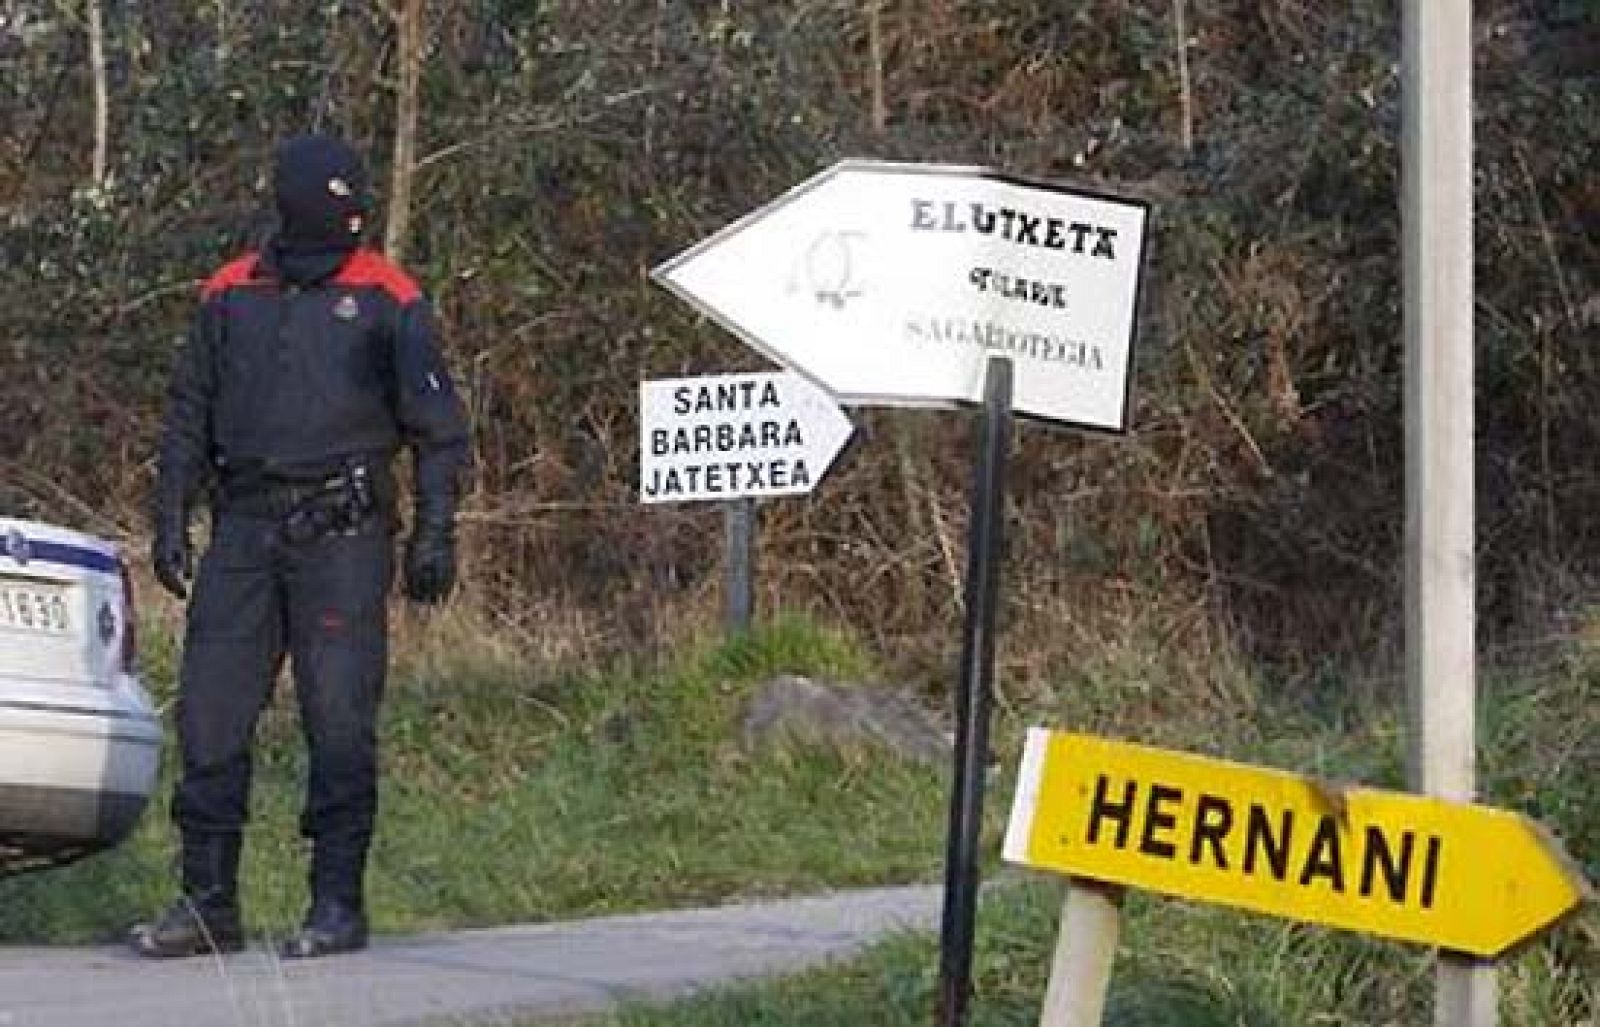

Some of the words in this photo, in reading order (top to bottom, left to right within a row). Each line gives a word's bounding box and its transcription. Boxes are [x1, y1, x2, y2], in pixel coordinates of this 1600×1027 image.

[909, 198, 1118, 259] ELUTXETA
[674, 380, 780, 415] SANTA
[651, 419, 803, 455] BARBARA
[645, 459, 810, 496] JATETXEA
[1085, 773, 1442, 909] HERNANI
